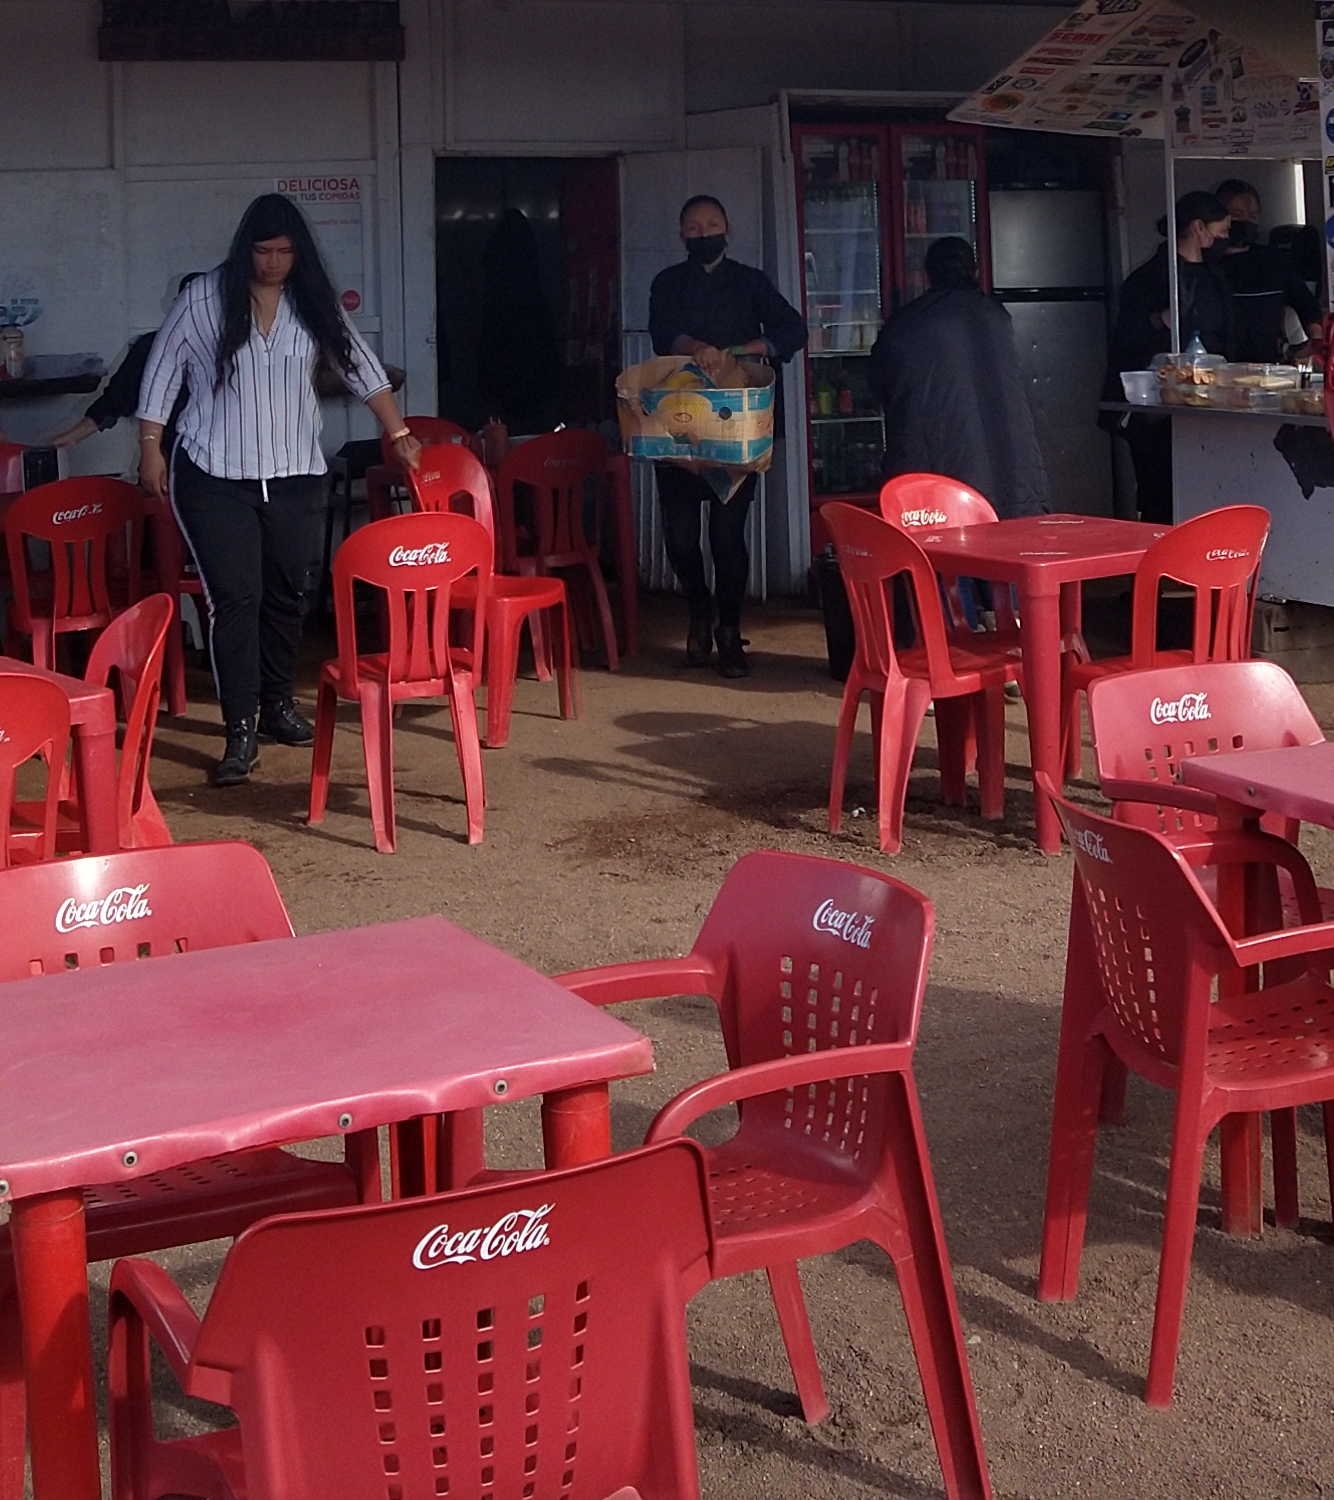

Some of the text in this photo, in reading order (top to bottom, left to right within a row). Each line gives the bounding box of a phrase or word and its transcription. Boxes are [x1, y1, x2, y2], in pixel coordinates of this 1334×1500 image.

[277, 178, 360, 192] DELICIOSA
[300, 193, 317, 201] TUS
[319, 192, 360, 201] COMIDAS
[388, 541, 451, 567] Coca-Cola
[1150, 692, 1210, 725] Coca-Cola
[55, 883, 151, 933] Coca-Cola
[812, 898, 875, 949] Coca-Cola
[413, 1202, 557, 1270] Coca-Cola
